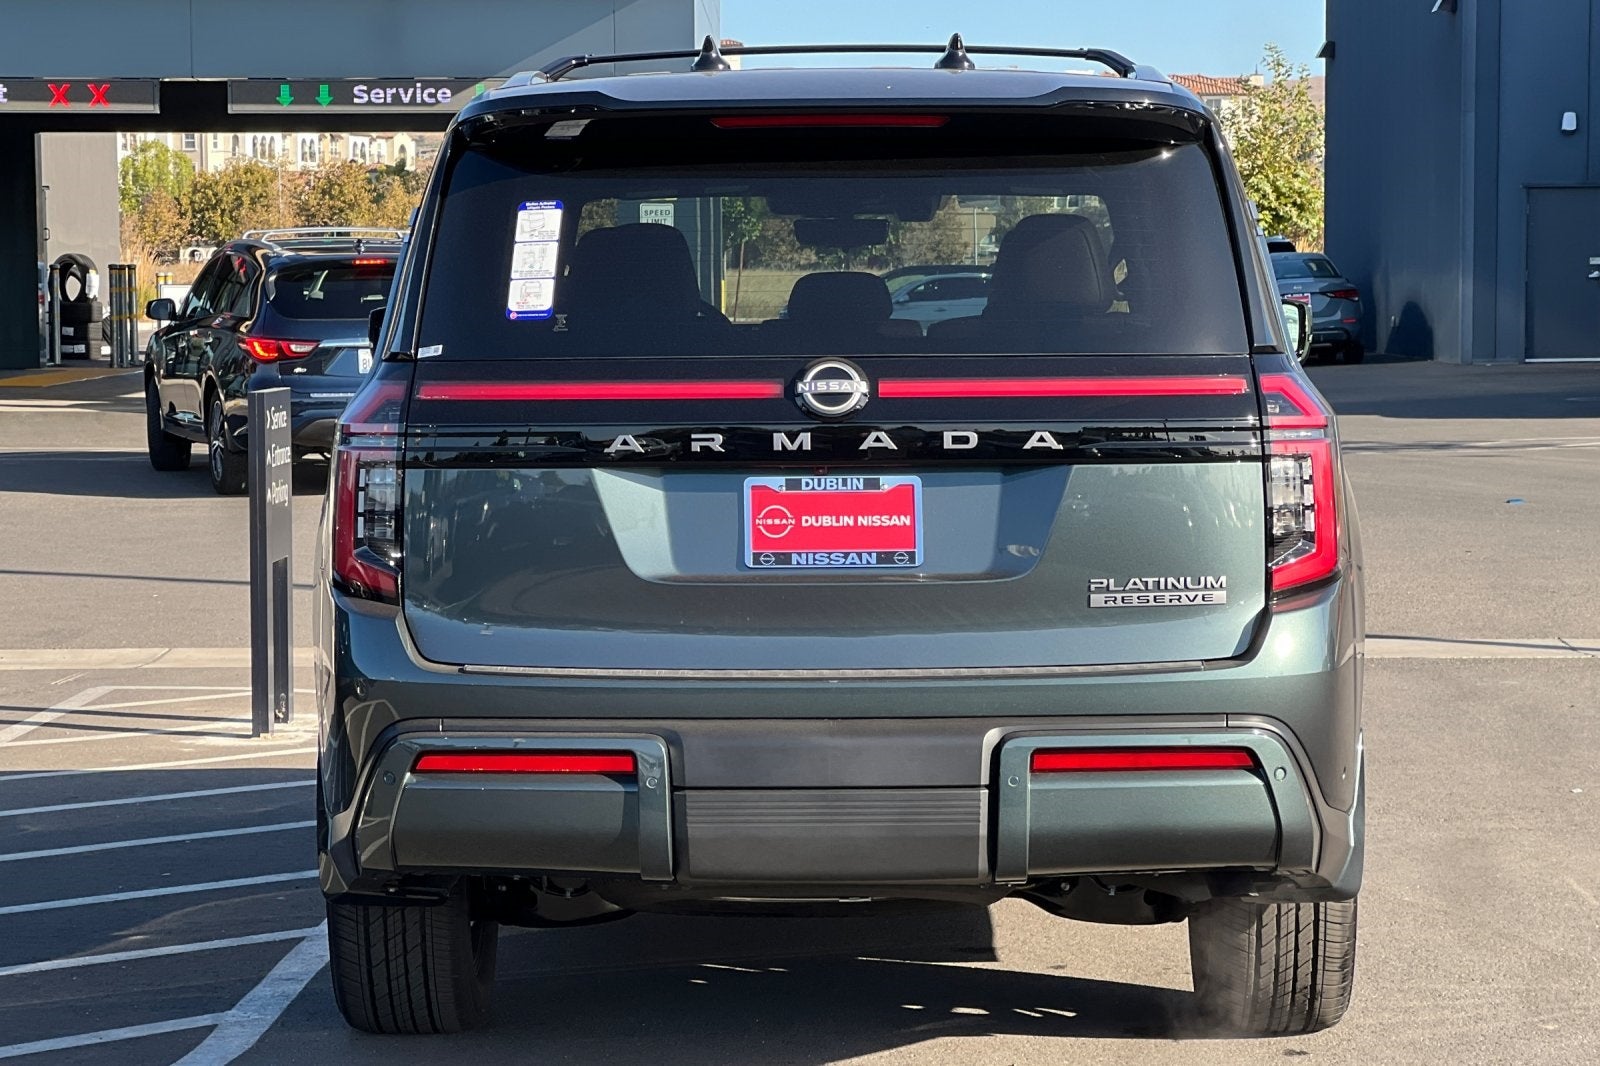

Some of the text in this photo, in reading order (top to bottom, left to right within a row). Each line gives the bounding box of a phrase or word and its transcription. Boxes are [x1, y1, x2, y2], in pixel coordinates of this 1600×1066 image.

[353, 82, 452, 104] Service
[643, 209, 671, 217] SPEED
[798, 381, 867, 393] NISSAN
[271, 405, 288, 430] Service
[603, 430, 1065, 454] ARMADA
[271, 443, 291, 468] Entrance
[801, 477, 864, 491] DUBLIN
[271, 480, 289, 507] Parking
[755, 517, 795, 525] NISSAN
[801, 515, 911, 527] DUBLIN NISSAN
[791, 552, 877, 565] NISSAN
[1089, 575, 1227, 592] PLATINUM
[1103, 593, 1214, 605] RESERVE
